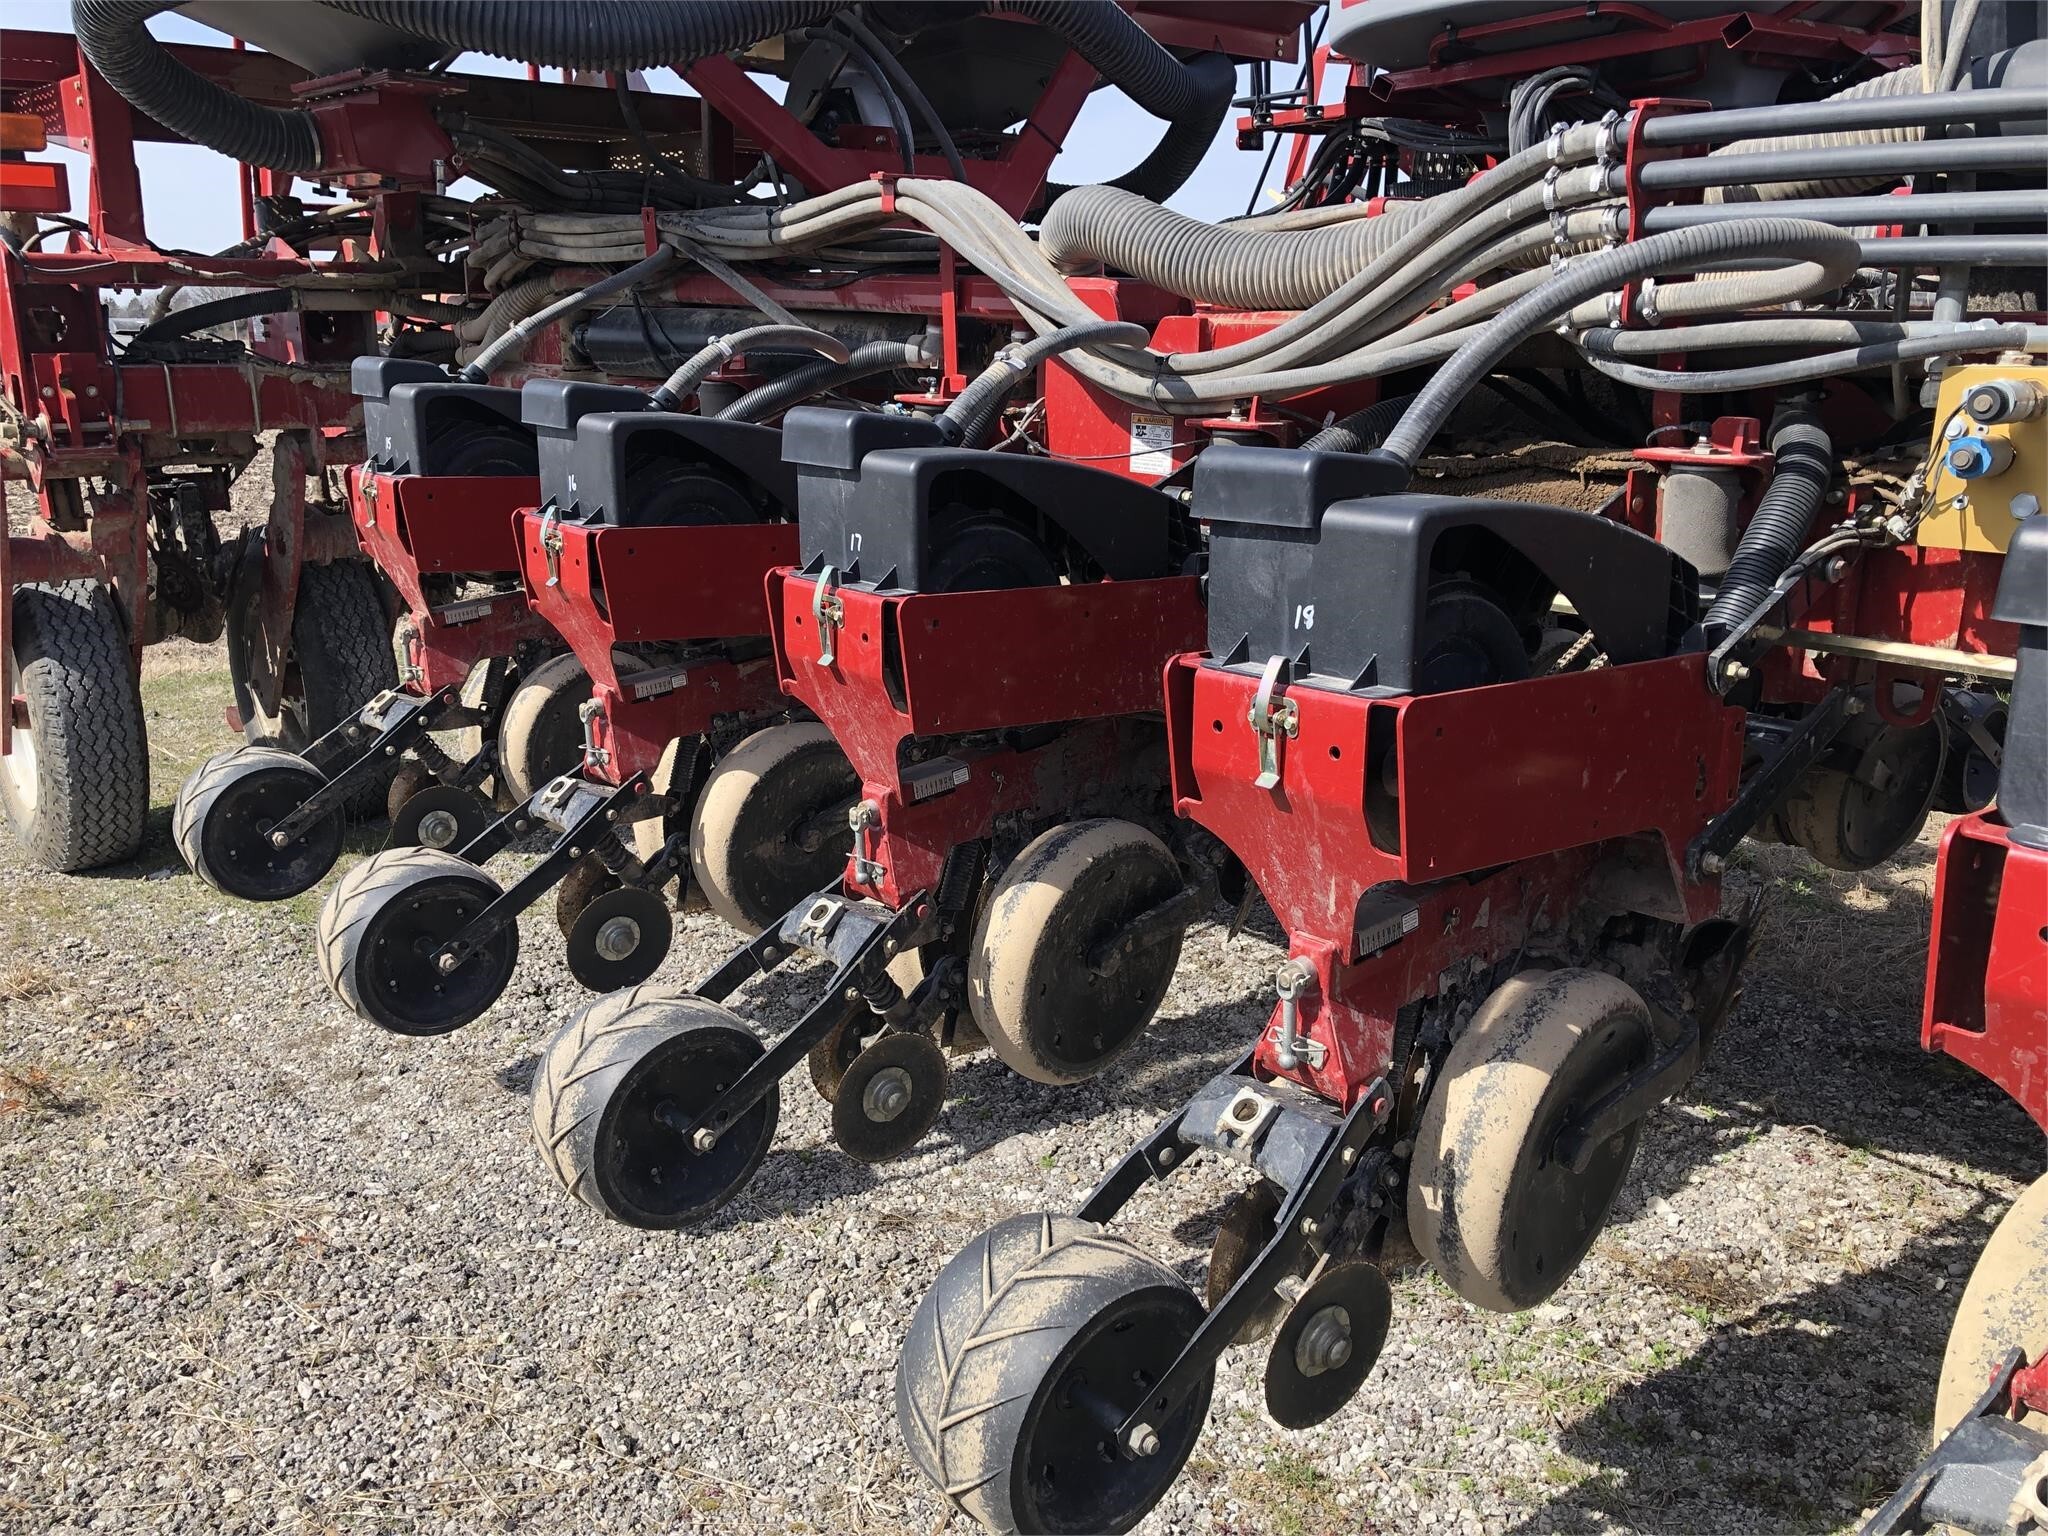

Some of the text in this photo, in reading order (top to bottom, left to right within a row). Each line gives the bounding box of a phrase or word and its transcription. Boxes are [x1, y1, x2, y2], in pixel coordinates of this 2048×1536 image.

[568, 474, 577, 492] 16
[850, 533, 862, 552] 17
[1294, 604, 1315, 630] 18
